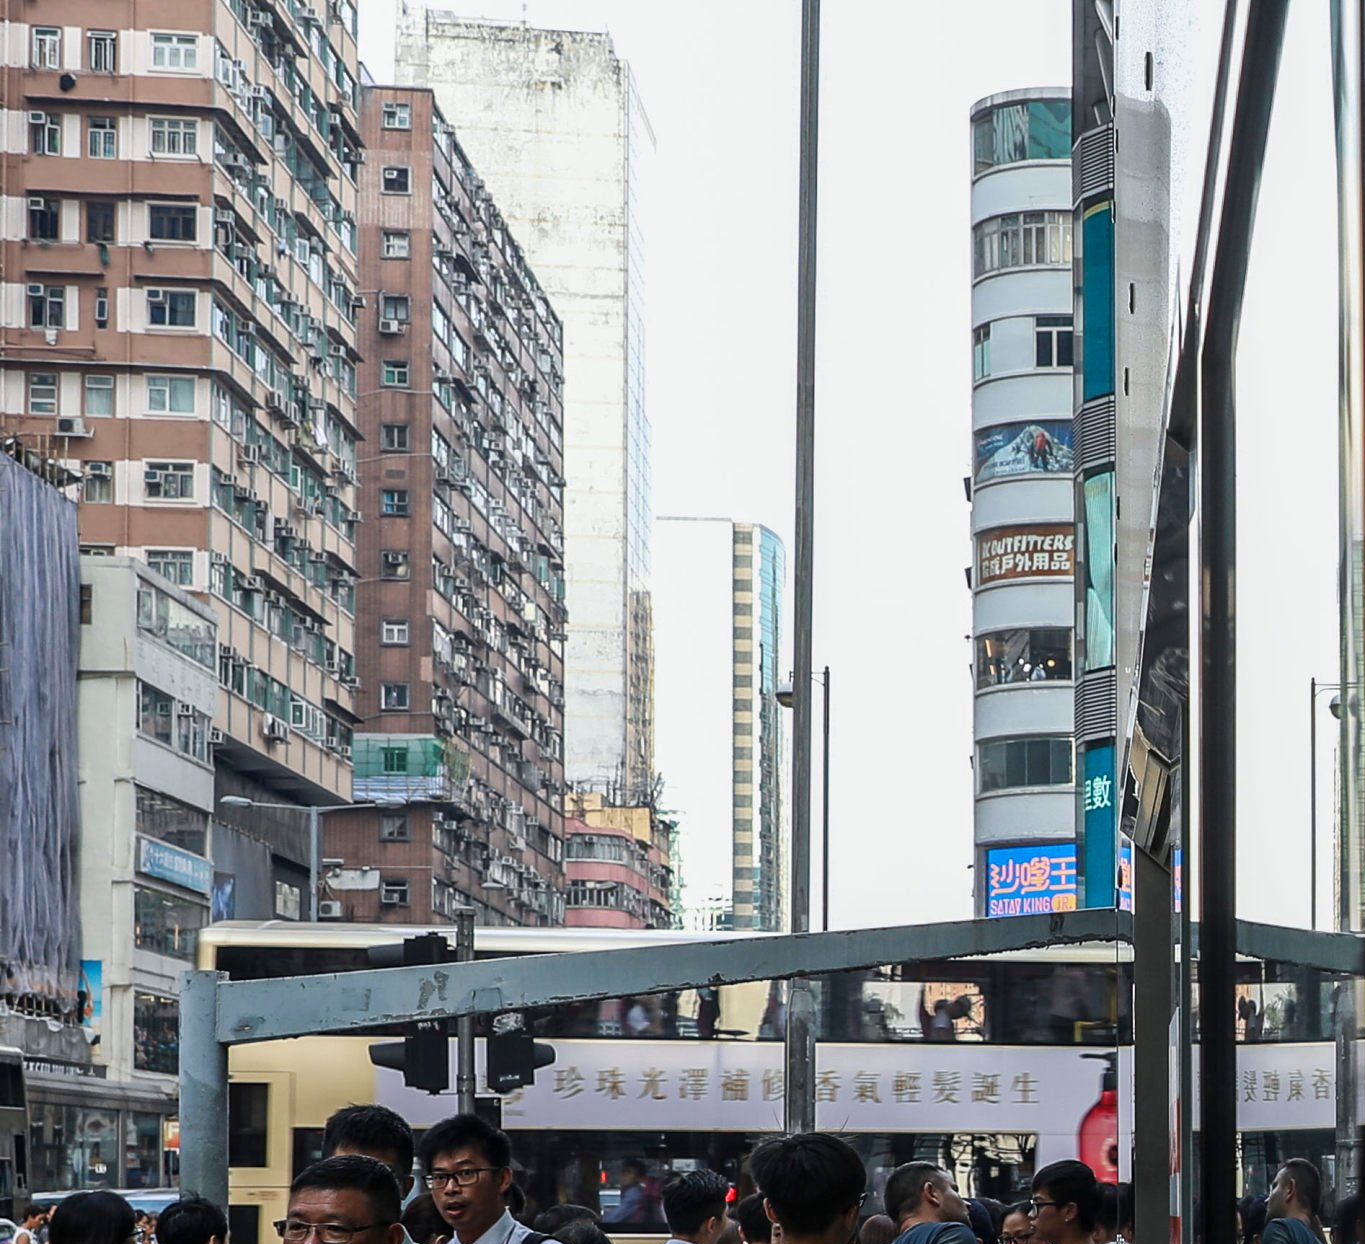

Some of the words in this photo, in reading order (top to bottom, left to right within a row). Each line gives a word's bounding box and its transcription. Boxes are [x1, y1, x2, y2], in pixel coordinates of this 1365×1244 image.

[990, 856, 1077, 897] 沙嗲王
[990, 897, 1022, 916] SATAY
[1023, 896, 1051, 913] KING
[816, 1070, 1041, 1104] 香氣輕髮誕生
